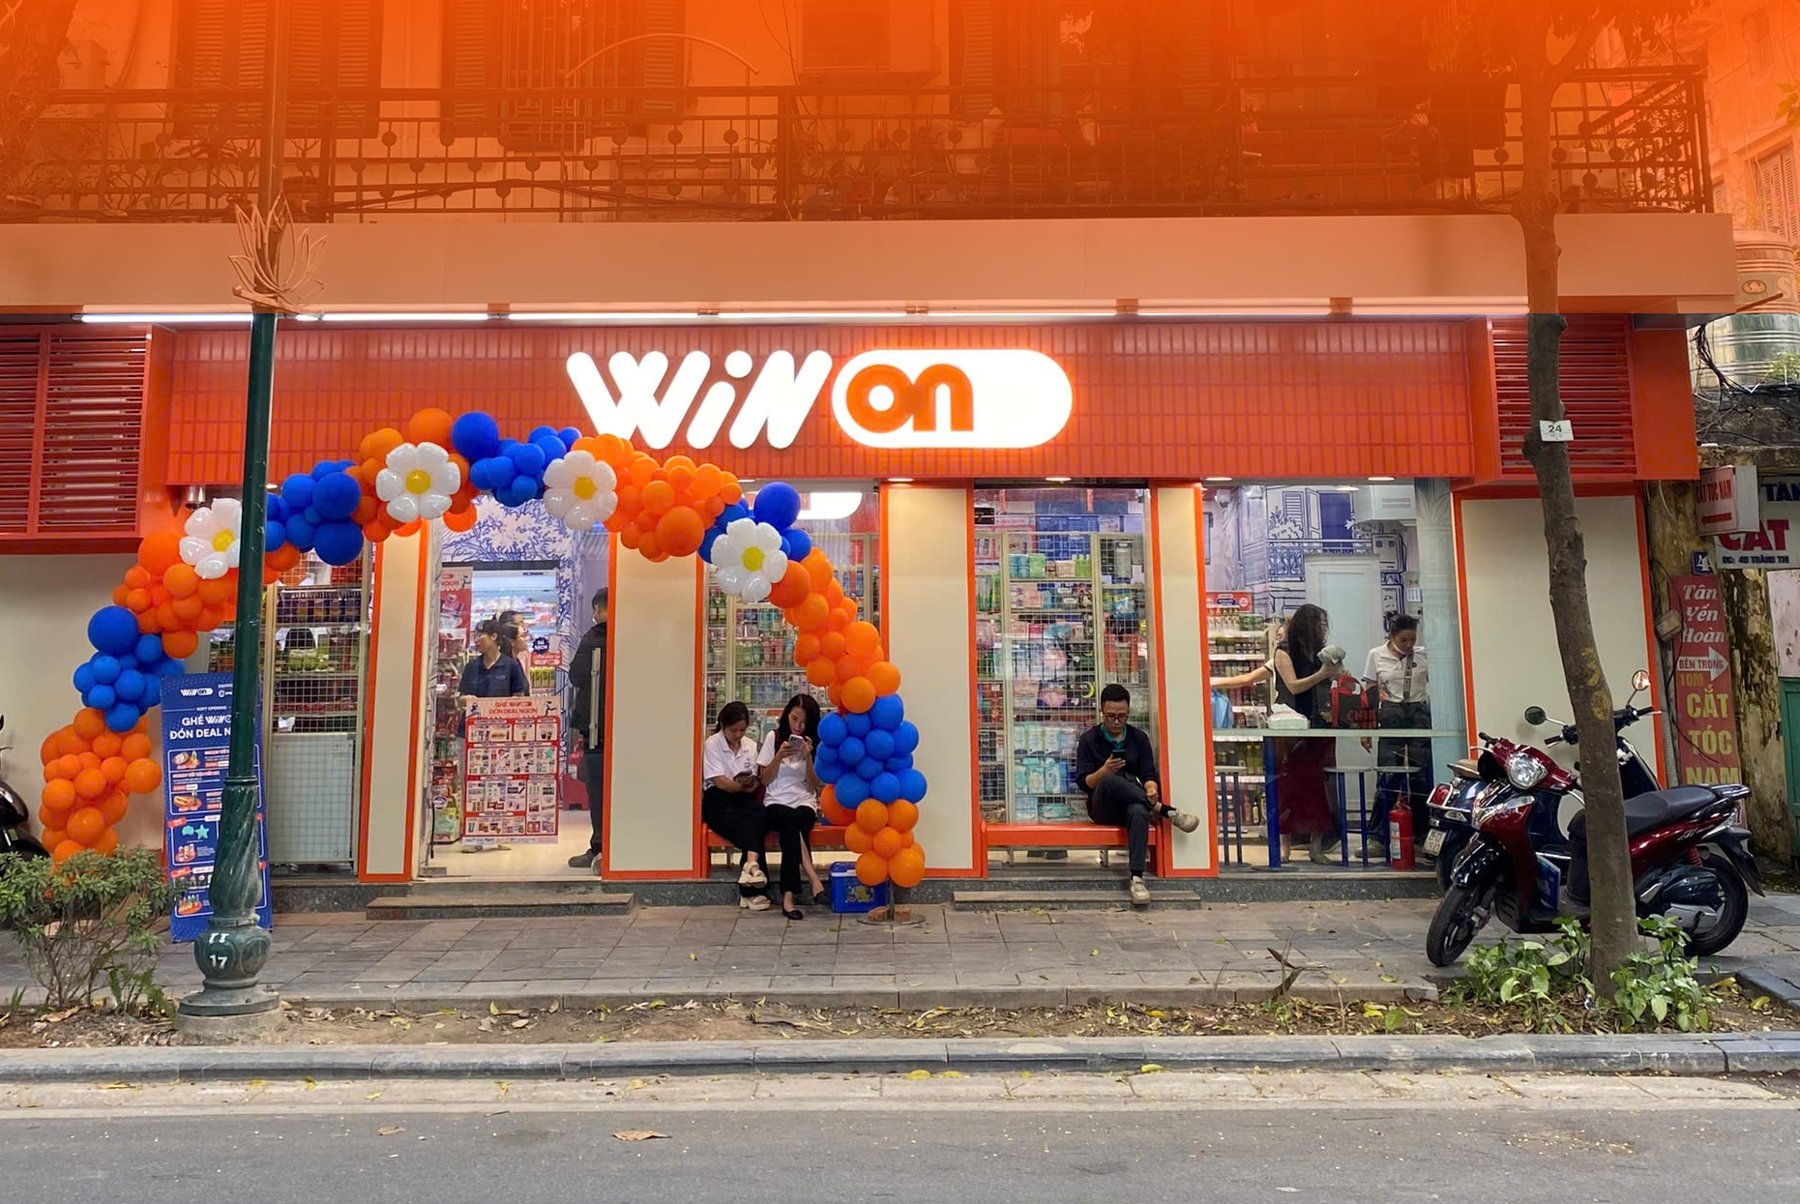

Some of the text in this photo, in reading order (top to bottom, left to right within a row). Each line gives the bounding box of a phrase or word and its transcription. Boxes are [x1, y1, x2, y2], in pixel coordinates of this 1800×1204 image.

[1548, 424, 1562, 433] 24
[1683, 584, 1718, 600] Tân
[1686, 603, 1719, 622] Yến
[1682, 626, 1725, 643] Hoàn
[1679, 658, 1725, 670] BÊN TRONG
[1686, 684, 1729, 718] CẮT
[182, 714, 204, 726] GHÉ
[169, 728, 194, 740] ĐÓN
[196, 728, 222, 738] DEAL
[1688, 725, 1733, 755] TÓC
[1686, 767, 1739, 786] NAM
[209, 954, 228, 969] 17
